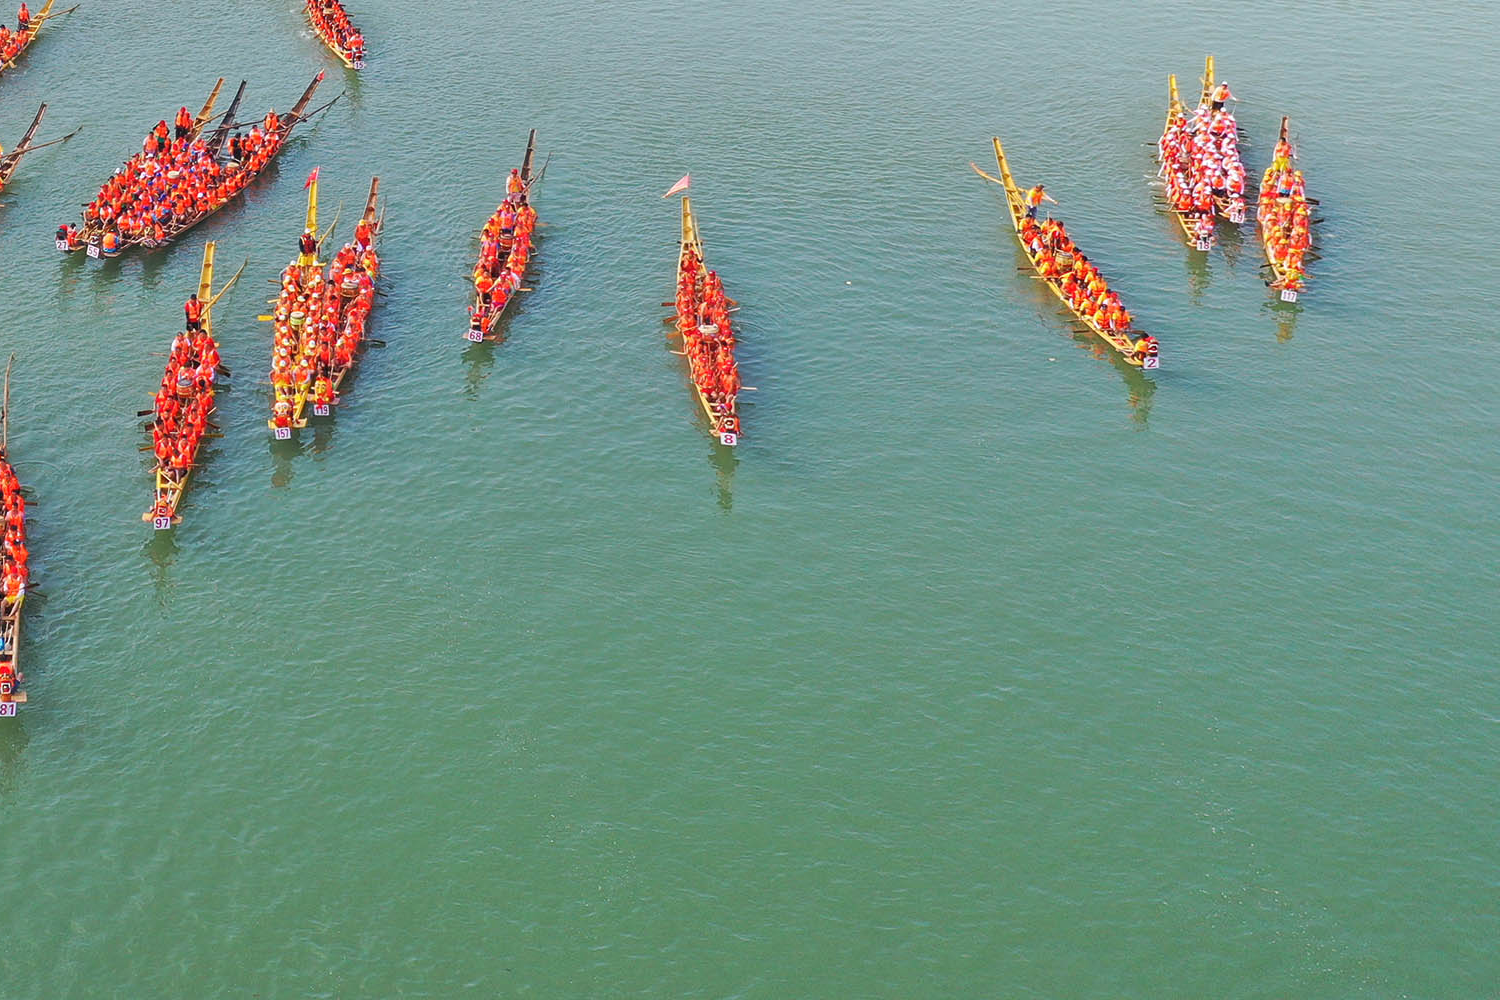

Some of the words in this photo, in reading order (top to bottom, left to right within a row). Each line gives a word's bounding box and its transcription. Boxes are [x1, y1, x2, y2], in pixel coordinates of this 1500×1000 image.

[56, 241, 67, 249] 27
[1199, 240, 1210, 249] 18
[88, 246, 98, 256] 55
[469, 331, 482, 341] 68
[1147, 358, 1157, 368] 2
[276, 429, 289, 438] 157
[724, 434, 733, 444] 8
[155, 518, 169, 529] 97
[0, 704, 15, 716] 81
